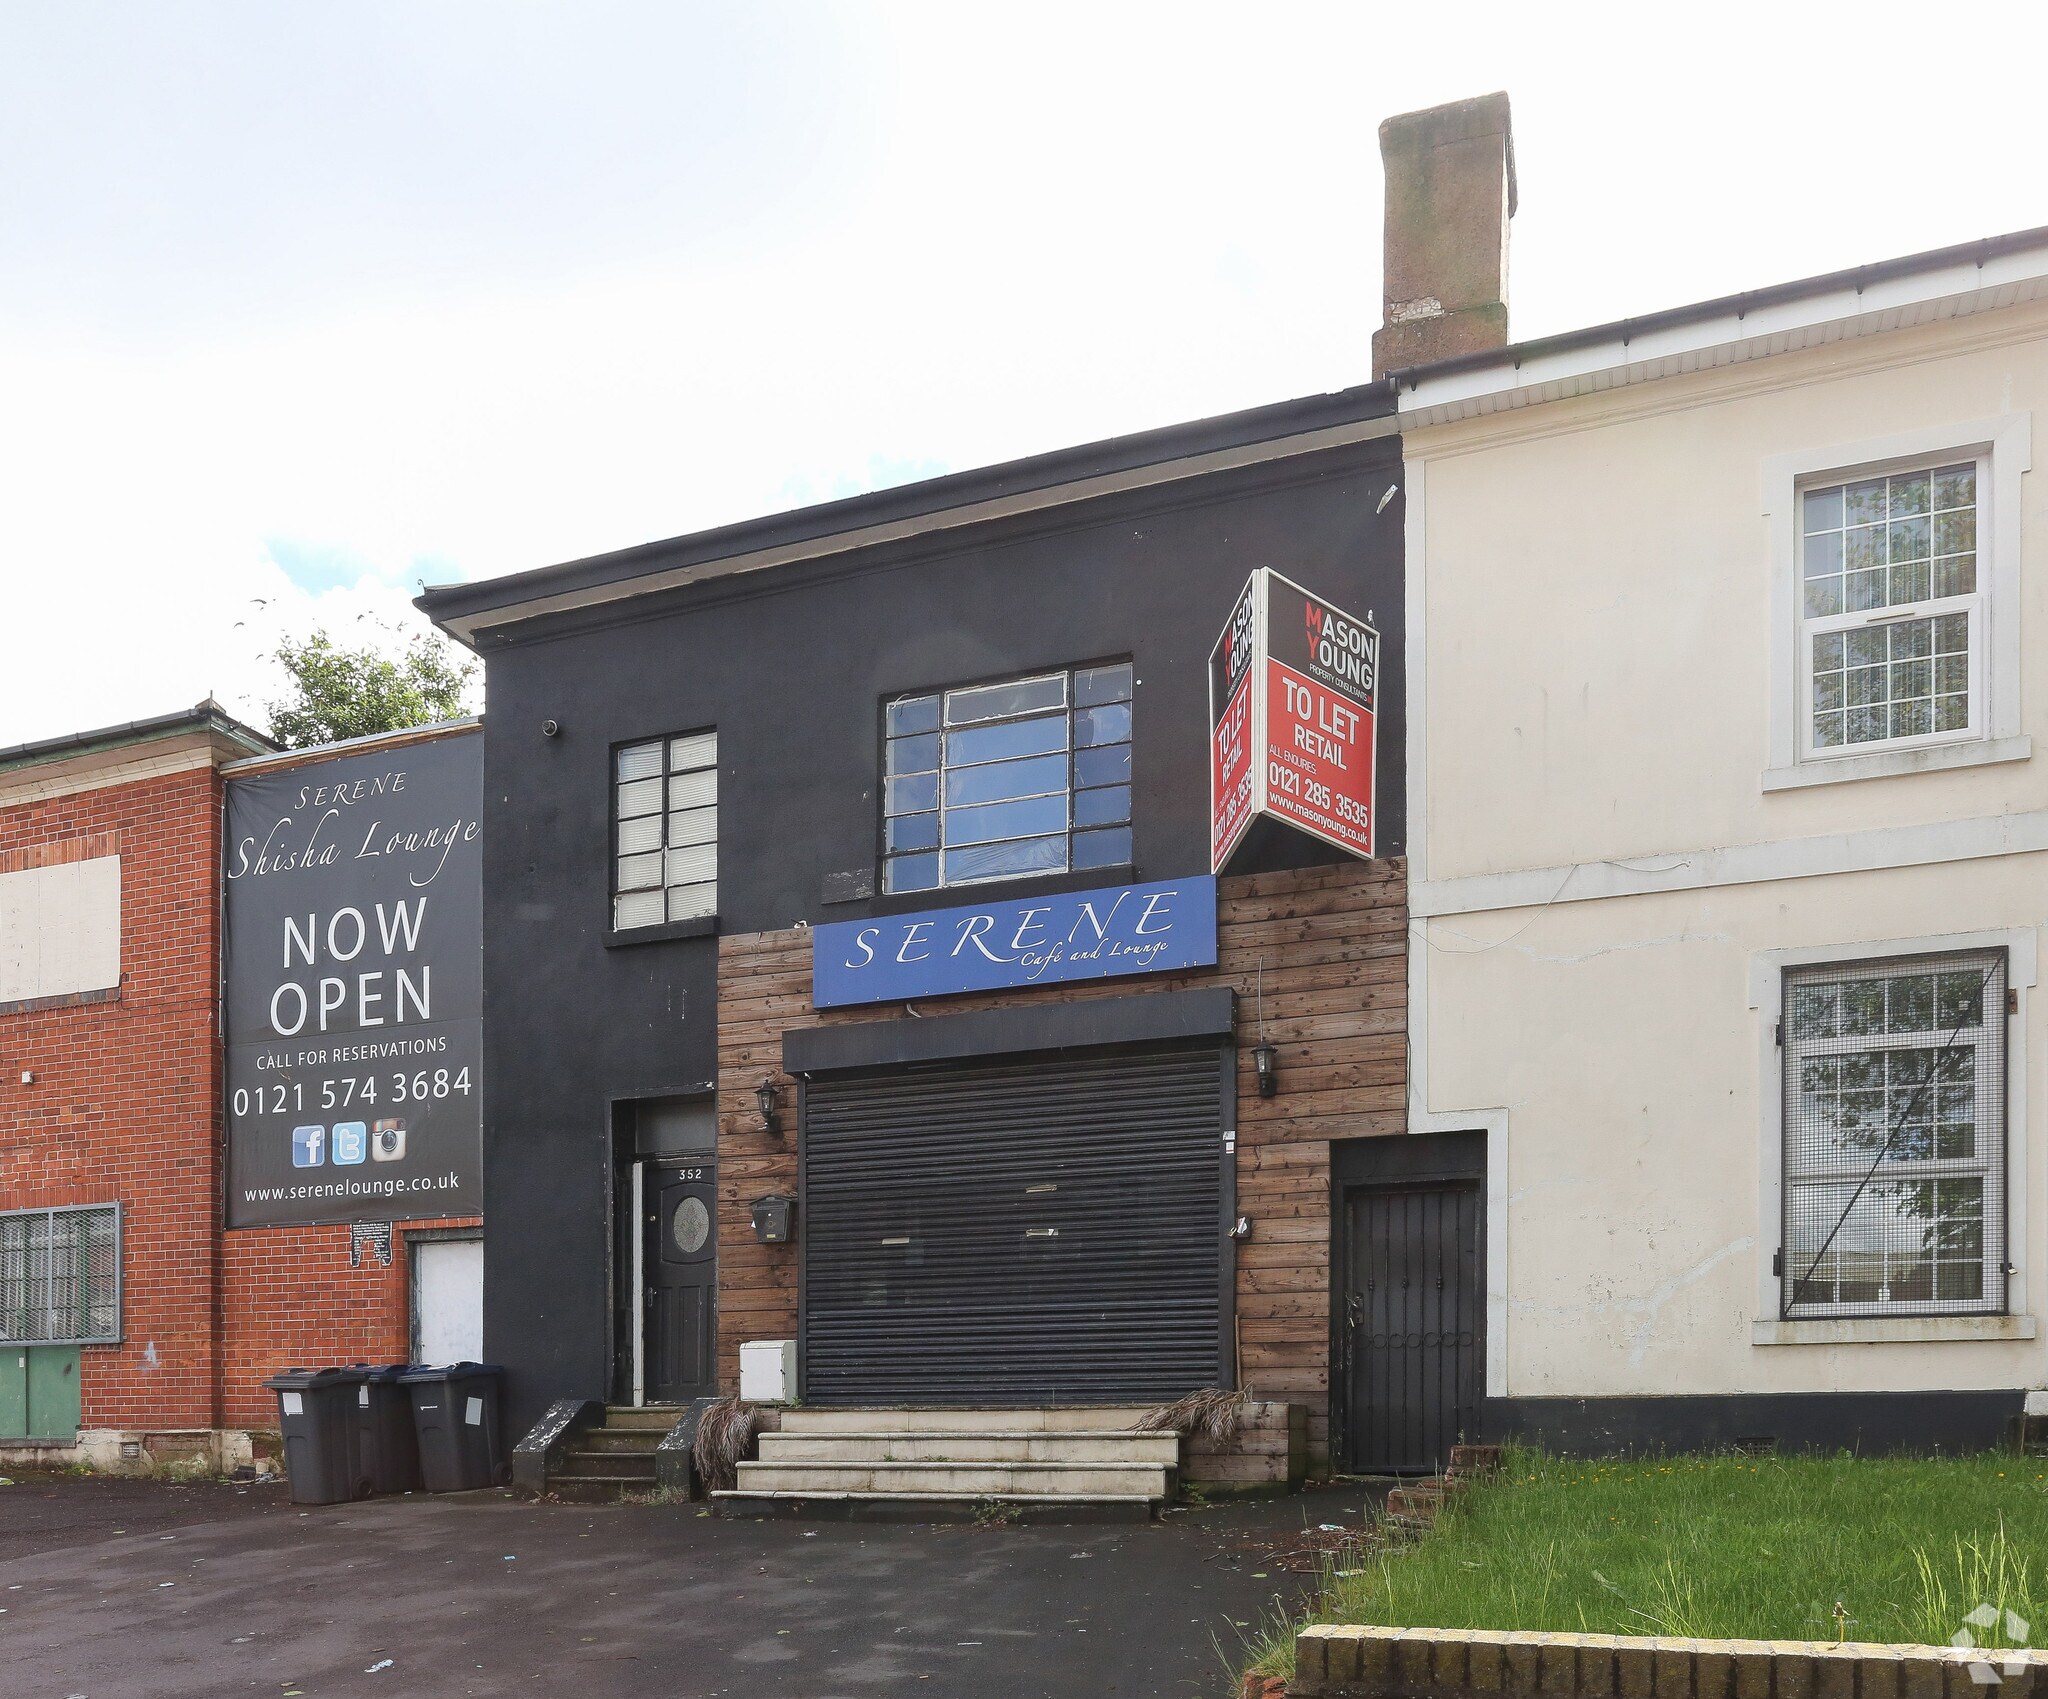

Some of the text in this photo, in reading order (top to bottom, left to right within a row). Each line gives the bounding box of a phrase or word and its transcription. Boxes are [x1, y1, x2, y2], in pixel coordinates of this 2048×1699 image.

[1305, 600, 1374, 664] MASON
[1306, 630, 1374, 690] YOUNG
[1309, 663, 1368, 702] PROPERTY CONSULTANTS
[1218, 721, 1230, 763] TO
[1231, 684, 1246, 742] LET
[1282, 676, 1360, 745] TO LET
[1222, 735, 1242, 787] RETAIL
[1269, 744, 1283, 759] ALL
[1294, 723, 1347, 770] RETAIL
[294, 772, 407, 810] SERENE
[1269, 761, 1368, 828] 0121 285 3535
[1269, 791, 1368, 846] www.masonyoung.co.uk
[227, 808, 481, 887] Shisha Lounge
[283, 896, 427, 968] NOW
[845, 890, 1178, 968] SERENE
[1020, 938, 1168, 980] Café and Lounge
[270, 966, 430, 1036] OPEN
[256, 1036, 447, 1070] CALL FOR RESERVATIONS
[233, 1066, 472, 1117] 0121 574 3684
[245, 1171, 459, 1202] www.serenelounge.co.uk
[679, 1168, 702, 1181] 352
